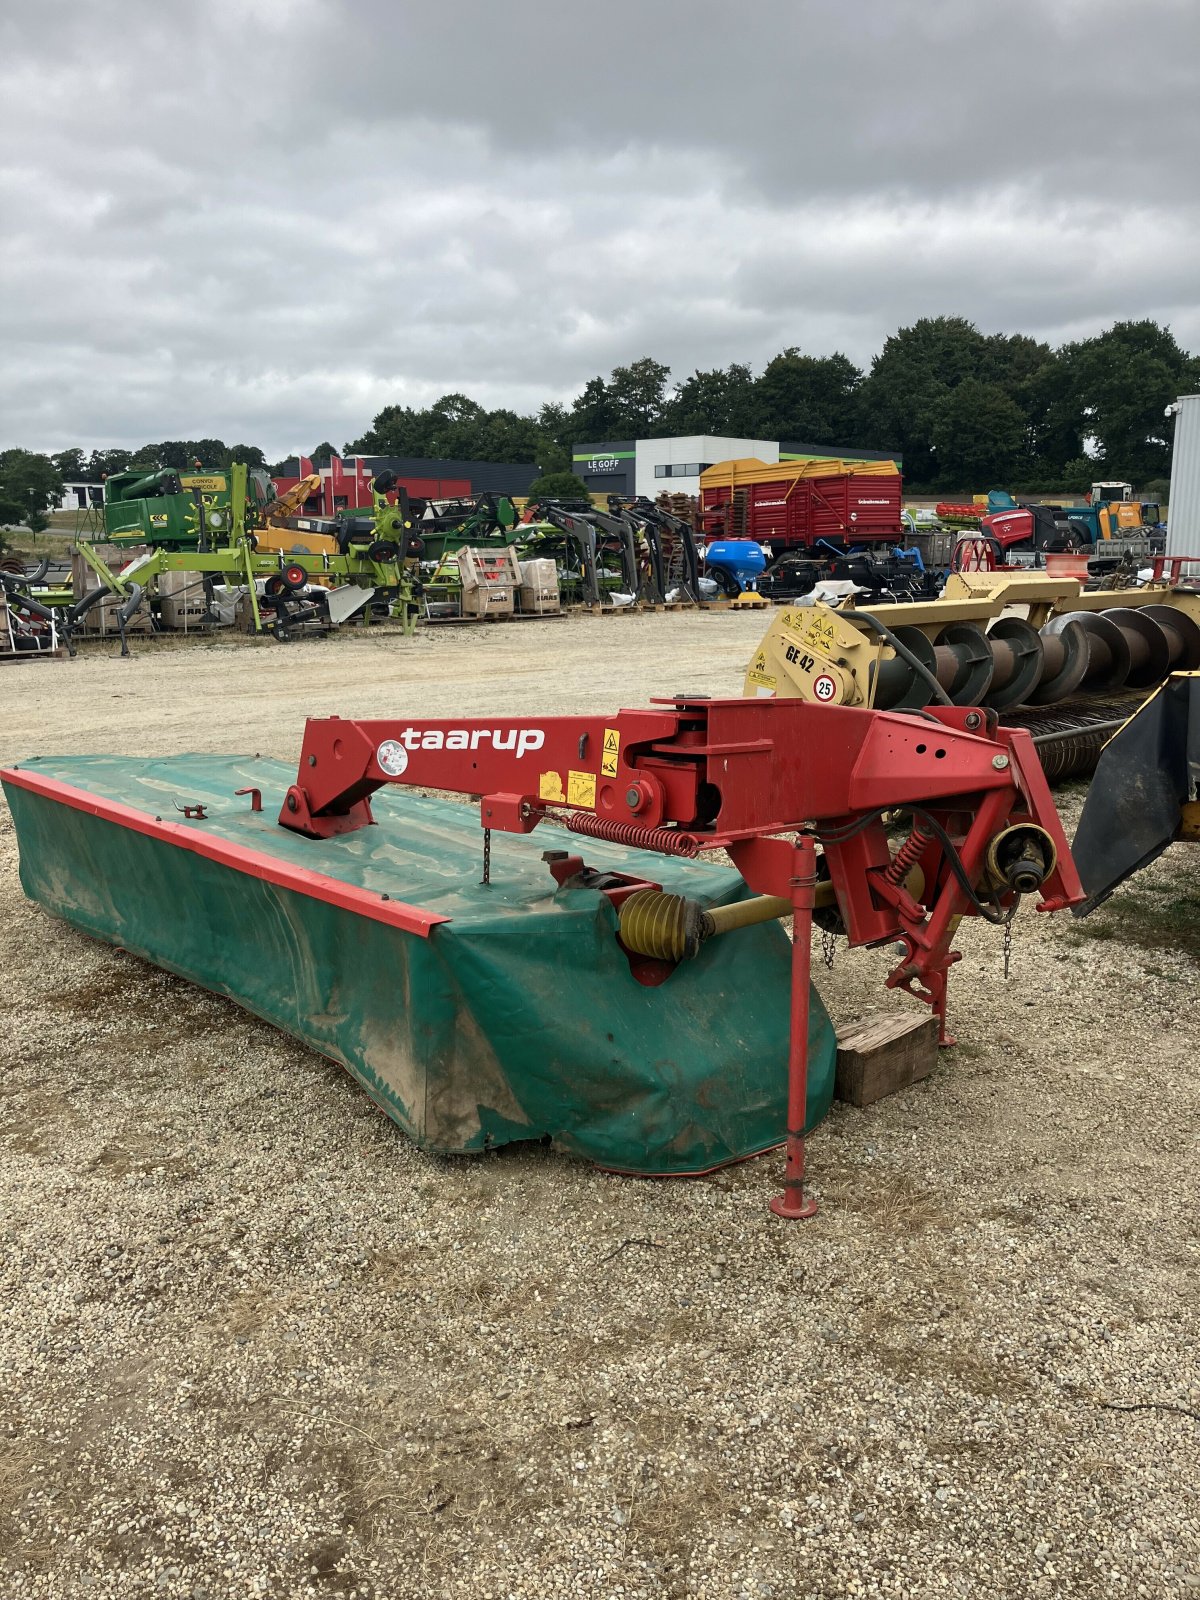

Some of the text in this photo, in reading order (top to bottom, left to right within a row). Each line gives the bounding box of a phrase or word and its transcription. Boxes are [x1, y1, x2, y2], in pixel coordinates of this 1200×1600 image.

[588, 460, 620, 469] LE GOFF
[785, 645, 815, 674] GE 42
[818, 681, 832, 696] 25
[400, 727, 546, 759] taarup
